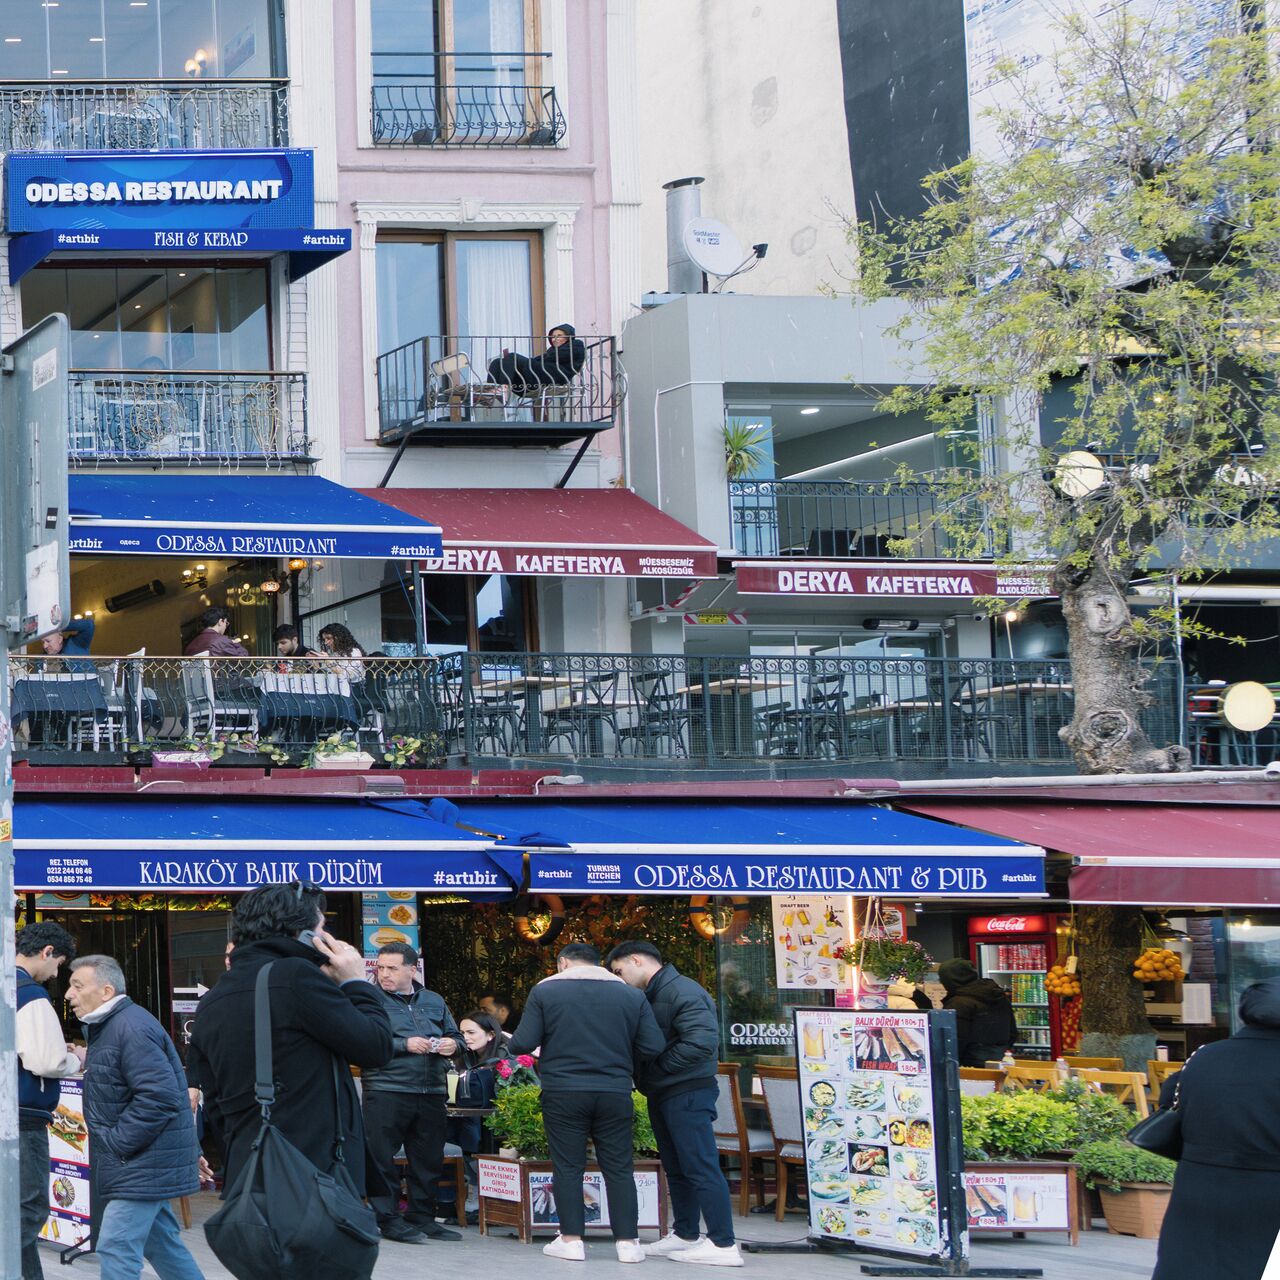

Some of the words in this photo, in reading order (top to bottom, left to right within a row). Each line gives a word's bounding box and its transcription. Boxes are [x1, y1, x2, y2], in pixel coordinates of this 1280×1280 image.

[25, 181, 122, 203] ODESSA
[125, 179, 282, 201] RESTAURANT
[58, 232, 100, 245] #artıbir
[154, 232, 184, 247] FISH
[186, 232, 200, 247] &
[204, 232, 248, 247] KEBAP
[303, 234, 345, 246] #artıbir
[156, 534, 227, 552] ODESSA
[231, 536, 337, 554] RESTAURANT
[516, 554, 625, 574] KAFETERYA
[778, 570, 854, 593] DERYA
[866, 575, 974, 595] KAFETERYA
[63, 858, 89, 866] TELEFON
[586, 864, 621, 872] TURKISH
[47, 867, 62, 875] 0212
[63, 867, 75, 875] 244
[139, 859, 238, 885] KARAKÖY
[245, 861, 300, 885] BALIK
[309, 859, 384, 885] DÜRÜM
[433, 869, 498, 885] #artıbir
[587, 872, 621, 880] KITCHEN
[634, 863, 738, 889] ODESSA
[745, 864, 902, 890] RESTAURANT
[911, 864, 931, 890] &
[938, 865, 988, 891] PUB
[855, 1017, 875, 1026] BALIK
[875, 1017, 900, 1027] DÜRÜM
[730, 1023, 795, 1037] ODESSA
[731, 1037, 794, 1045] RESTAURAN
[861, 1060, 878, 1070] FISH
[497, 1165, 518, 1174] EKMEK
